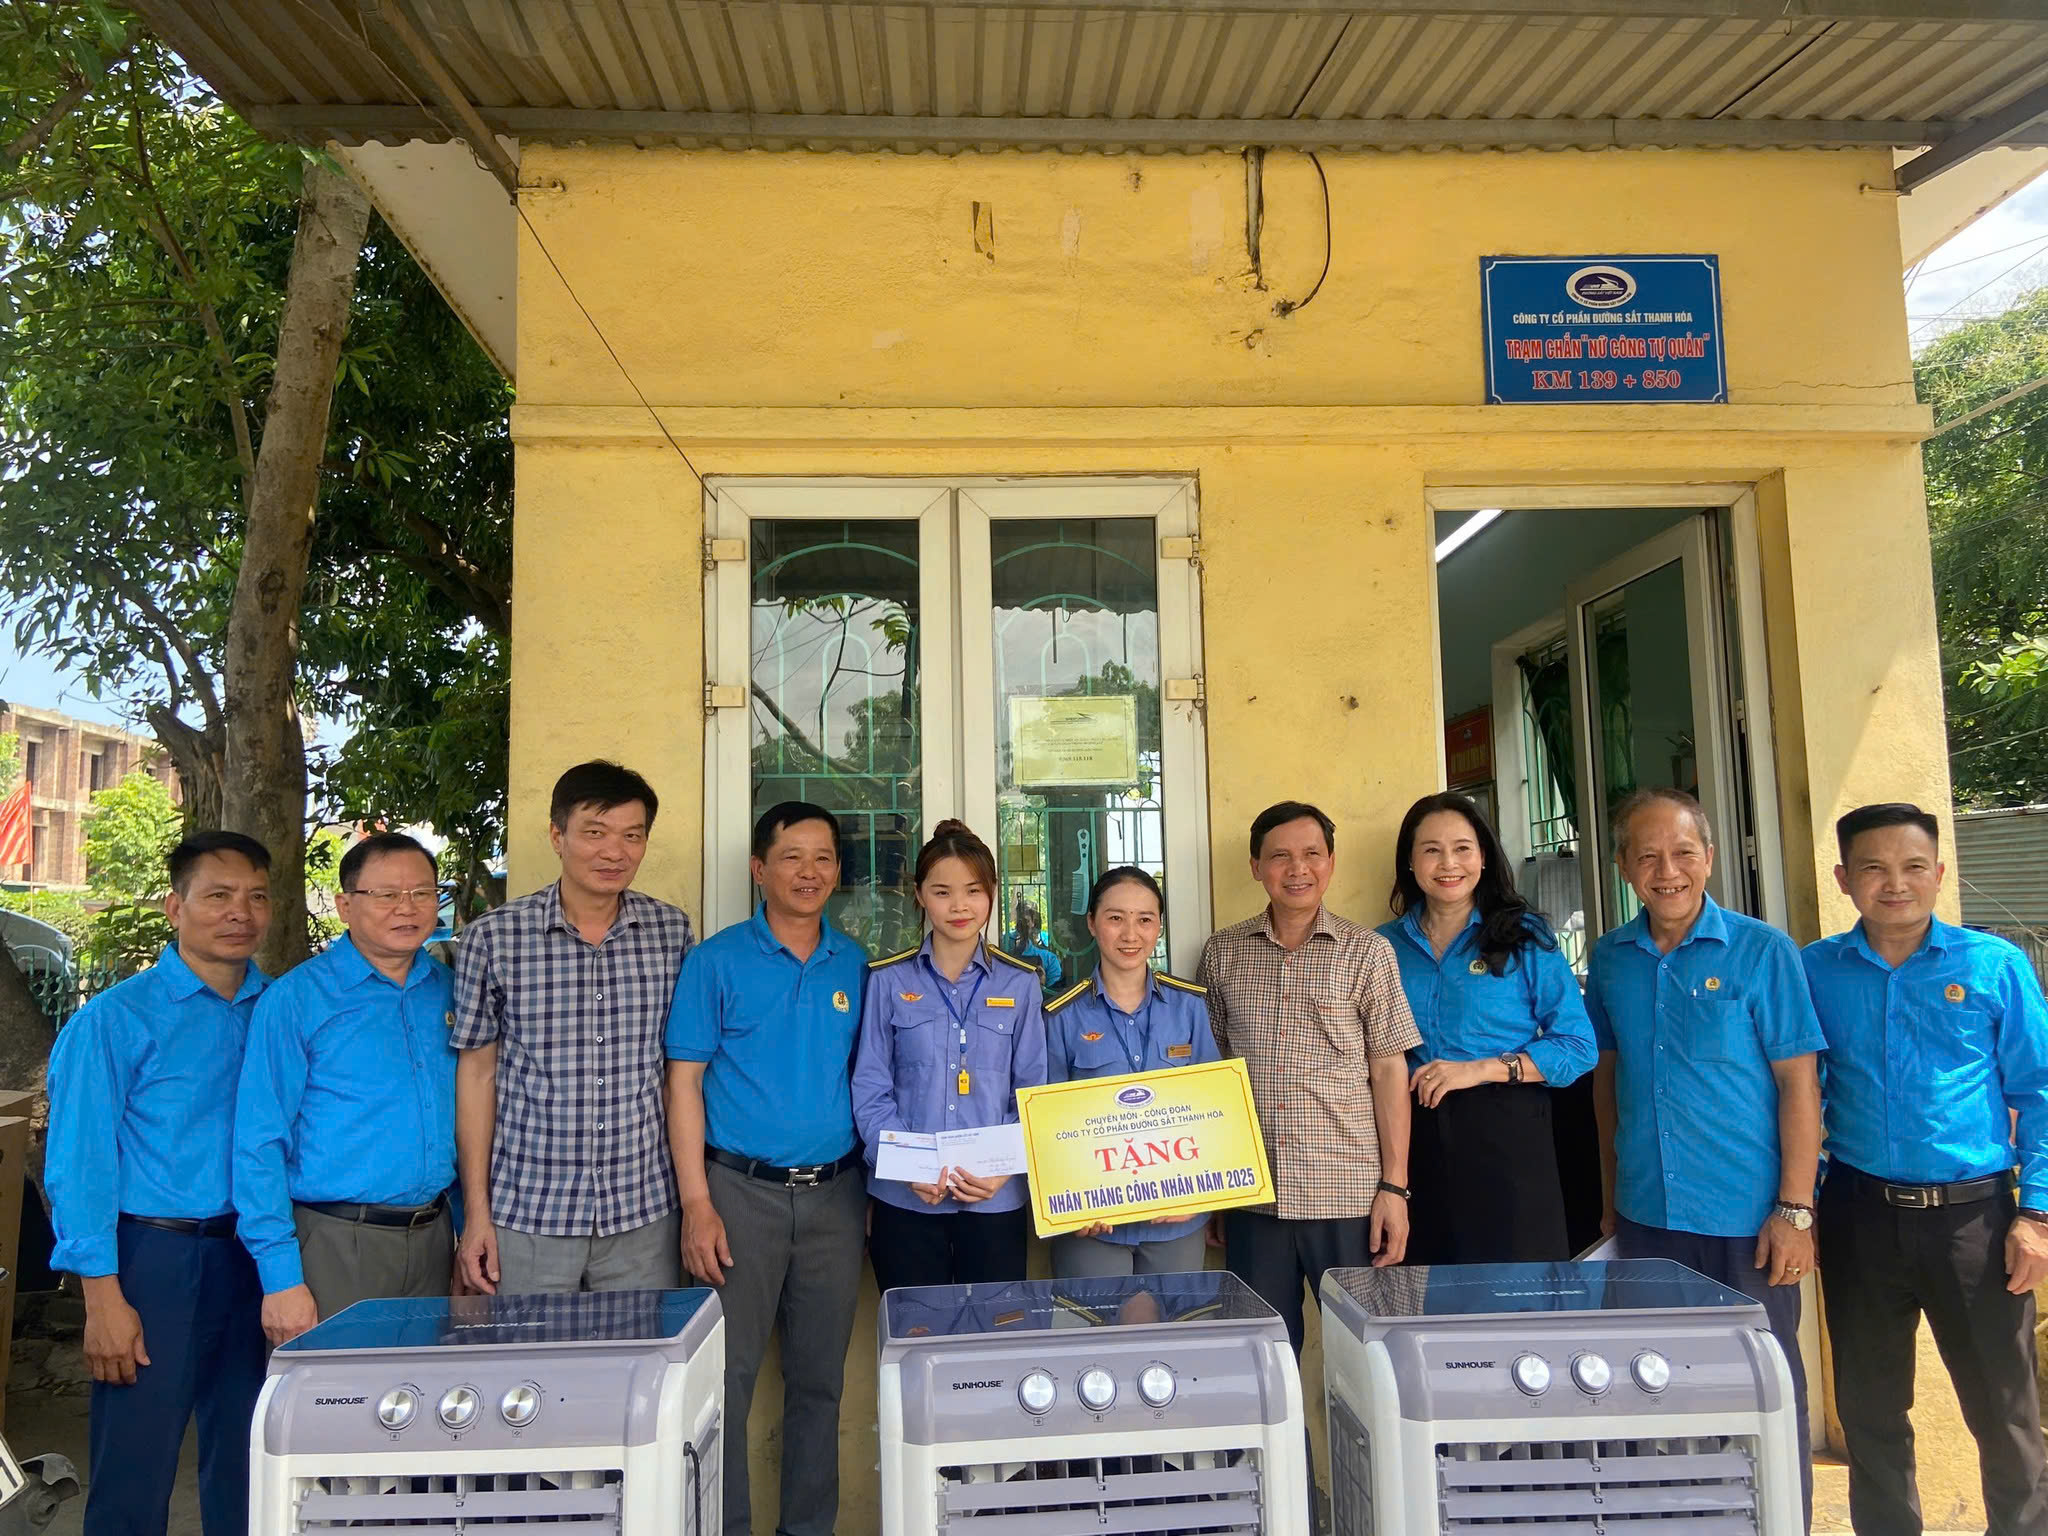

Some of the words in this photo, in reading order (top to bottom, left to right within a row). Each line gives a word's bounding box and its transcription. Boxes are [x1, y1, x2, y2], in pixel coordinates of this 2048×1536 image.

[1512, 312, 1537, 325] CÔNG
[1538, 313, 1550, 324] TY
[1625, 309, 1642, 323] SẮT
[1643, 312, 1673, 323] THANH
[1505, 338, 1543, 363] TRẠM
[1609, 334, 1646, 358] CÔNG
[1648, 336, 1666, 362] TỰ
[1532, 370, 1573, 390] KM
[1578, 370, 1617, 390] 139
[1623, 374, 1637, 388] +
[1642, 369, 1681, 389] 850
[1056, 1129, 1079, 1140] CÔNG
[1080, 1129, 1091, 1137] TY
[1160, 1114, 1176, 1126] SẮT
[1177, 1112, 1205, 1123] THANH
[1085, 1113, 1118, 1126] CHUYÊN
[1119, 1111, 1138, 1121] MÔN
[1144, 1107, 1167, 1118] CÔNG
[1094, 1136, 1200, 1175] TẶNG
[1048, 1189, 1082, 1214] NHÂN
[1084, 1184, 1124, 1209] THÁNG
[1125, 1179, 1159, 1203] CÔNG
[1160, 1173, 1194, 1198] NHÂN
[1196, 1169, 1225, 1193] NĂM
[1226, 1167, 1255, 1189] 2025
[1445, 1361, 1495, 1369] SUNHOUSE
[952, 1380, 1002, 1390] SUNHOUSE
[315, 1397, 366, 1405] SUNHOUSE
